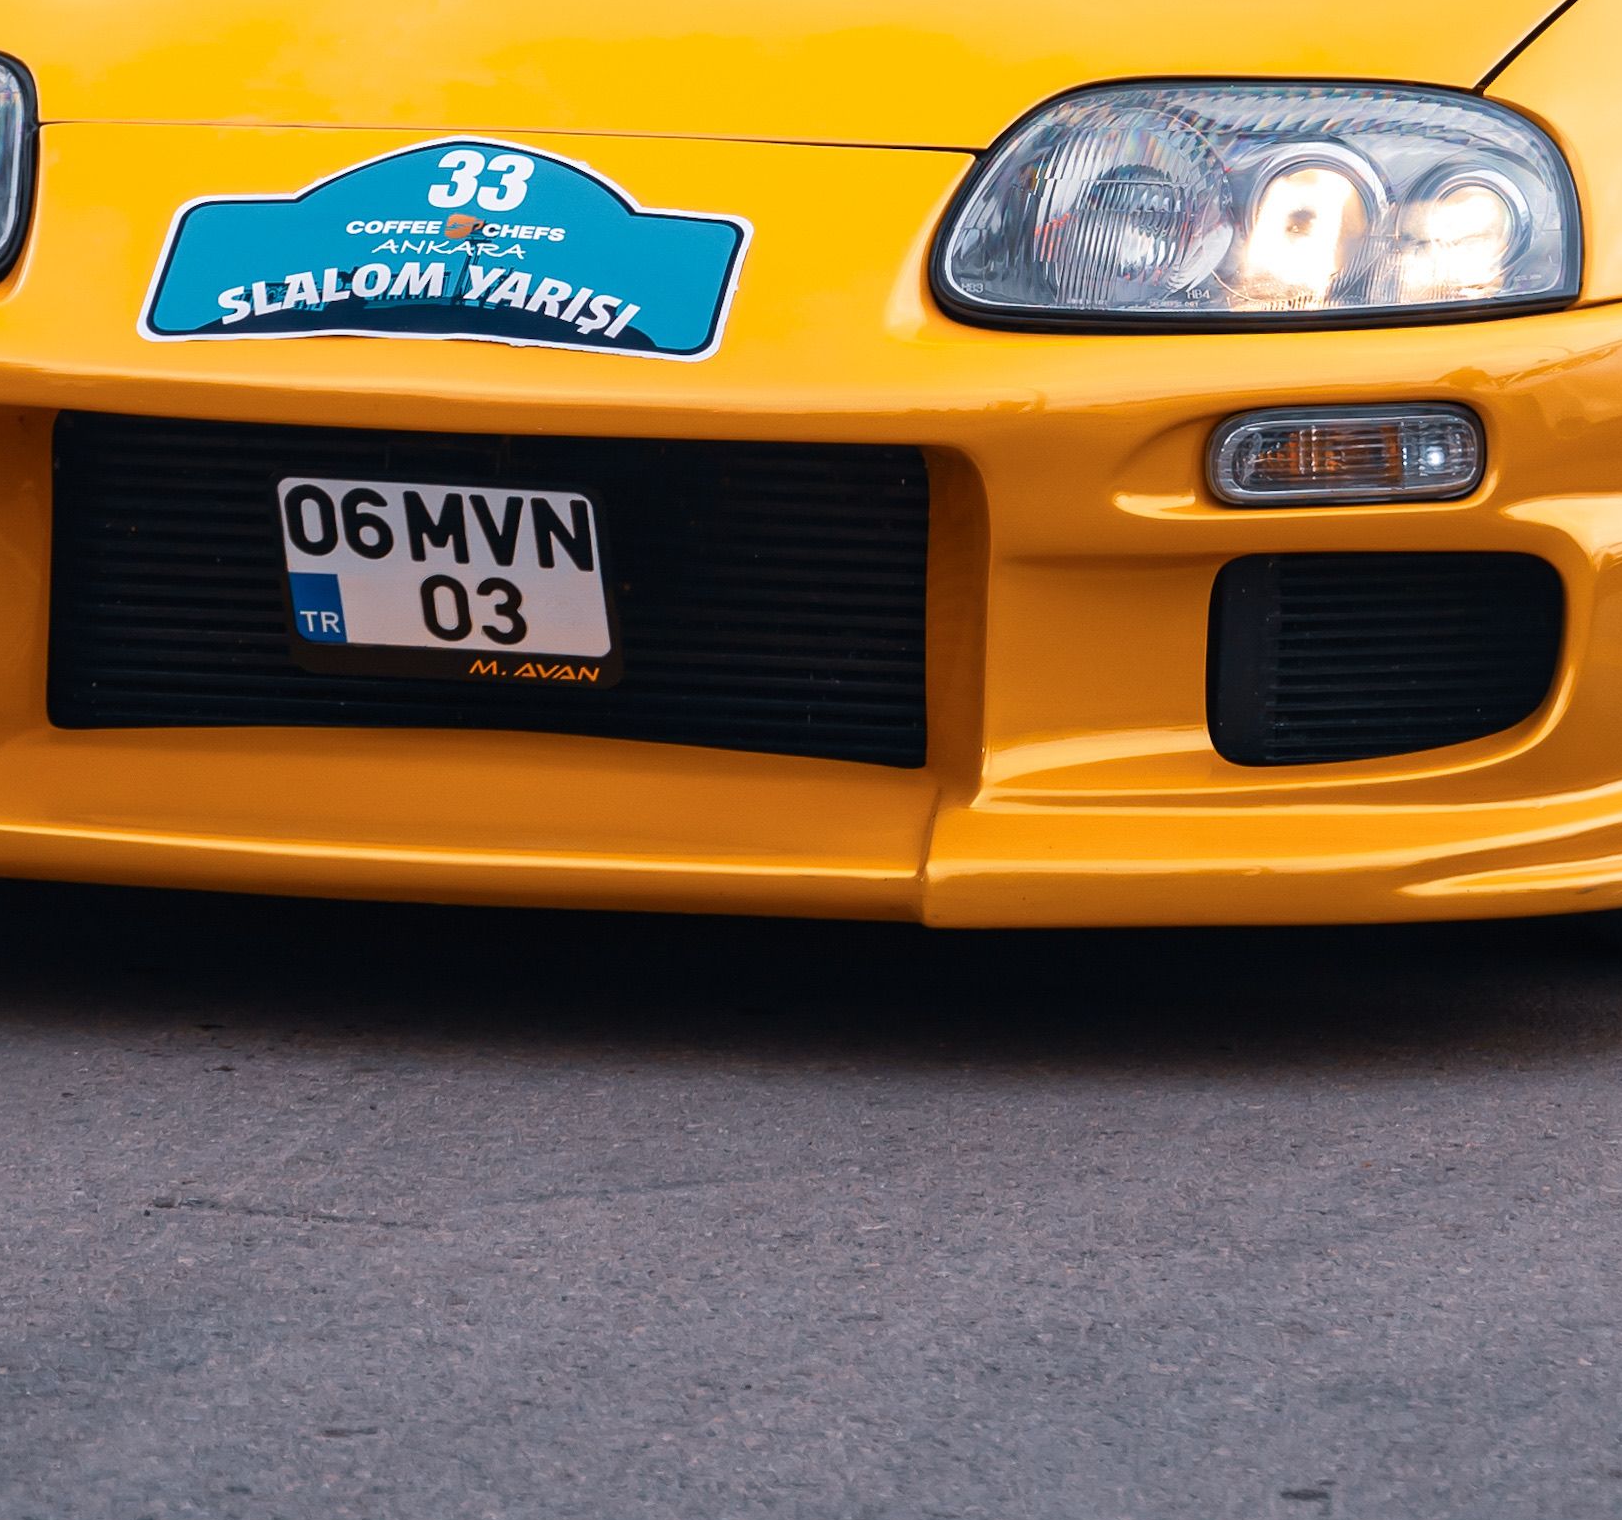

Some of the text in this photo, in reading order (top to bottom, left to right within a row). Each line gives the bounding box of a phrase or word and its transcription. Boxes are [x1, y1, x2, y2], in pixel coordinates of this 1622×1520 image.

[427, 149, 535, 212] 33
[345, 220, 566, 242] COFFEE CHEFS
[371, 238, 526, 260] ANKARA
[217, 261, 641, 339] SLALOM YARIŞI
[1186, 289, 1211, 299] HB4
[299, 610, 341, 634] TR
[420, 574, 527, 646] 03
[469, 659, 600, 683] M. AVAN
